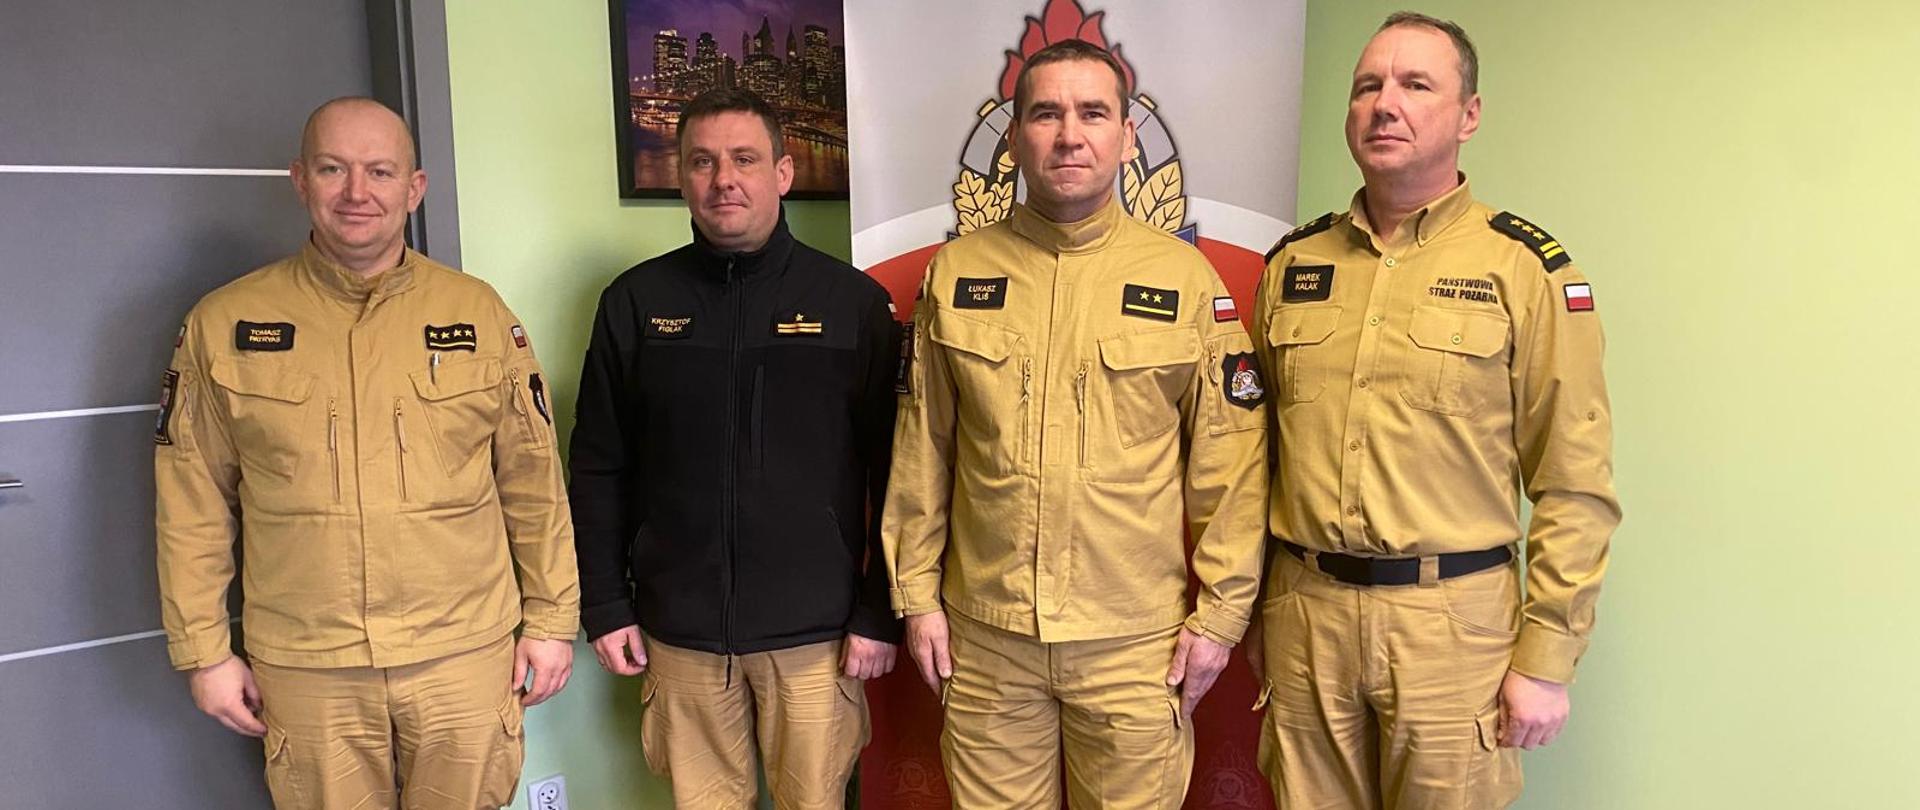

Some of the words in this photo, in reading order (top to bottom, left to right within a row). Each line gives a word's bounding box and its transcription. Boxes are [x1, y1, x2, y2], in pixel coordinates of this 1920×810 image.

[1295, 273, 1321, 281] MAREK
[968, 284, 996, 293] ŁUKASZ
[1295, 282, 1319, 290] KALAK
